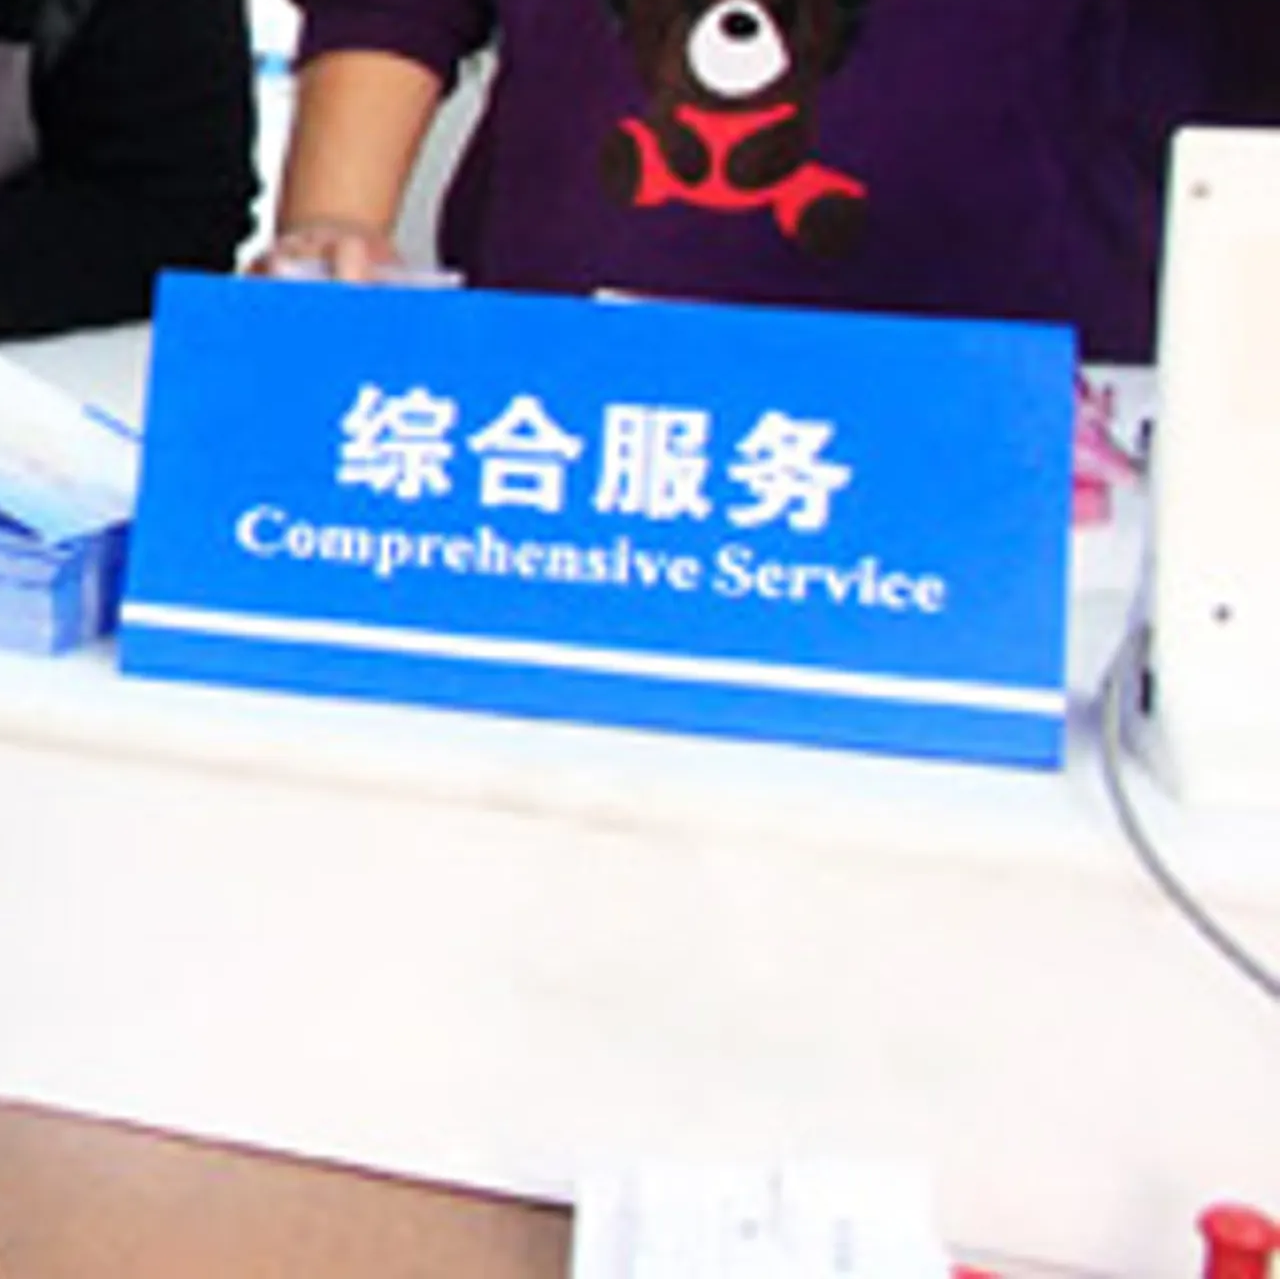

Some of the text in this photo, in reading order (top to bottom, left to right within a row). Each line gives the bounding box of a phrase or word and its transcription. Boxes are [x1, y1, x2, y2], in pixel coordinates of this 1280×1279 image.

[337, 385, 851, 531] 综合服务
[235, 504, 946, 614] Comprehensive Service
